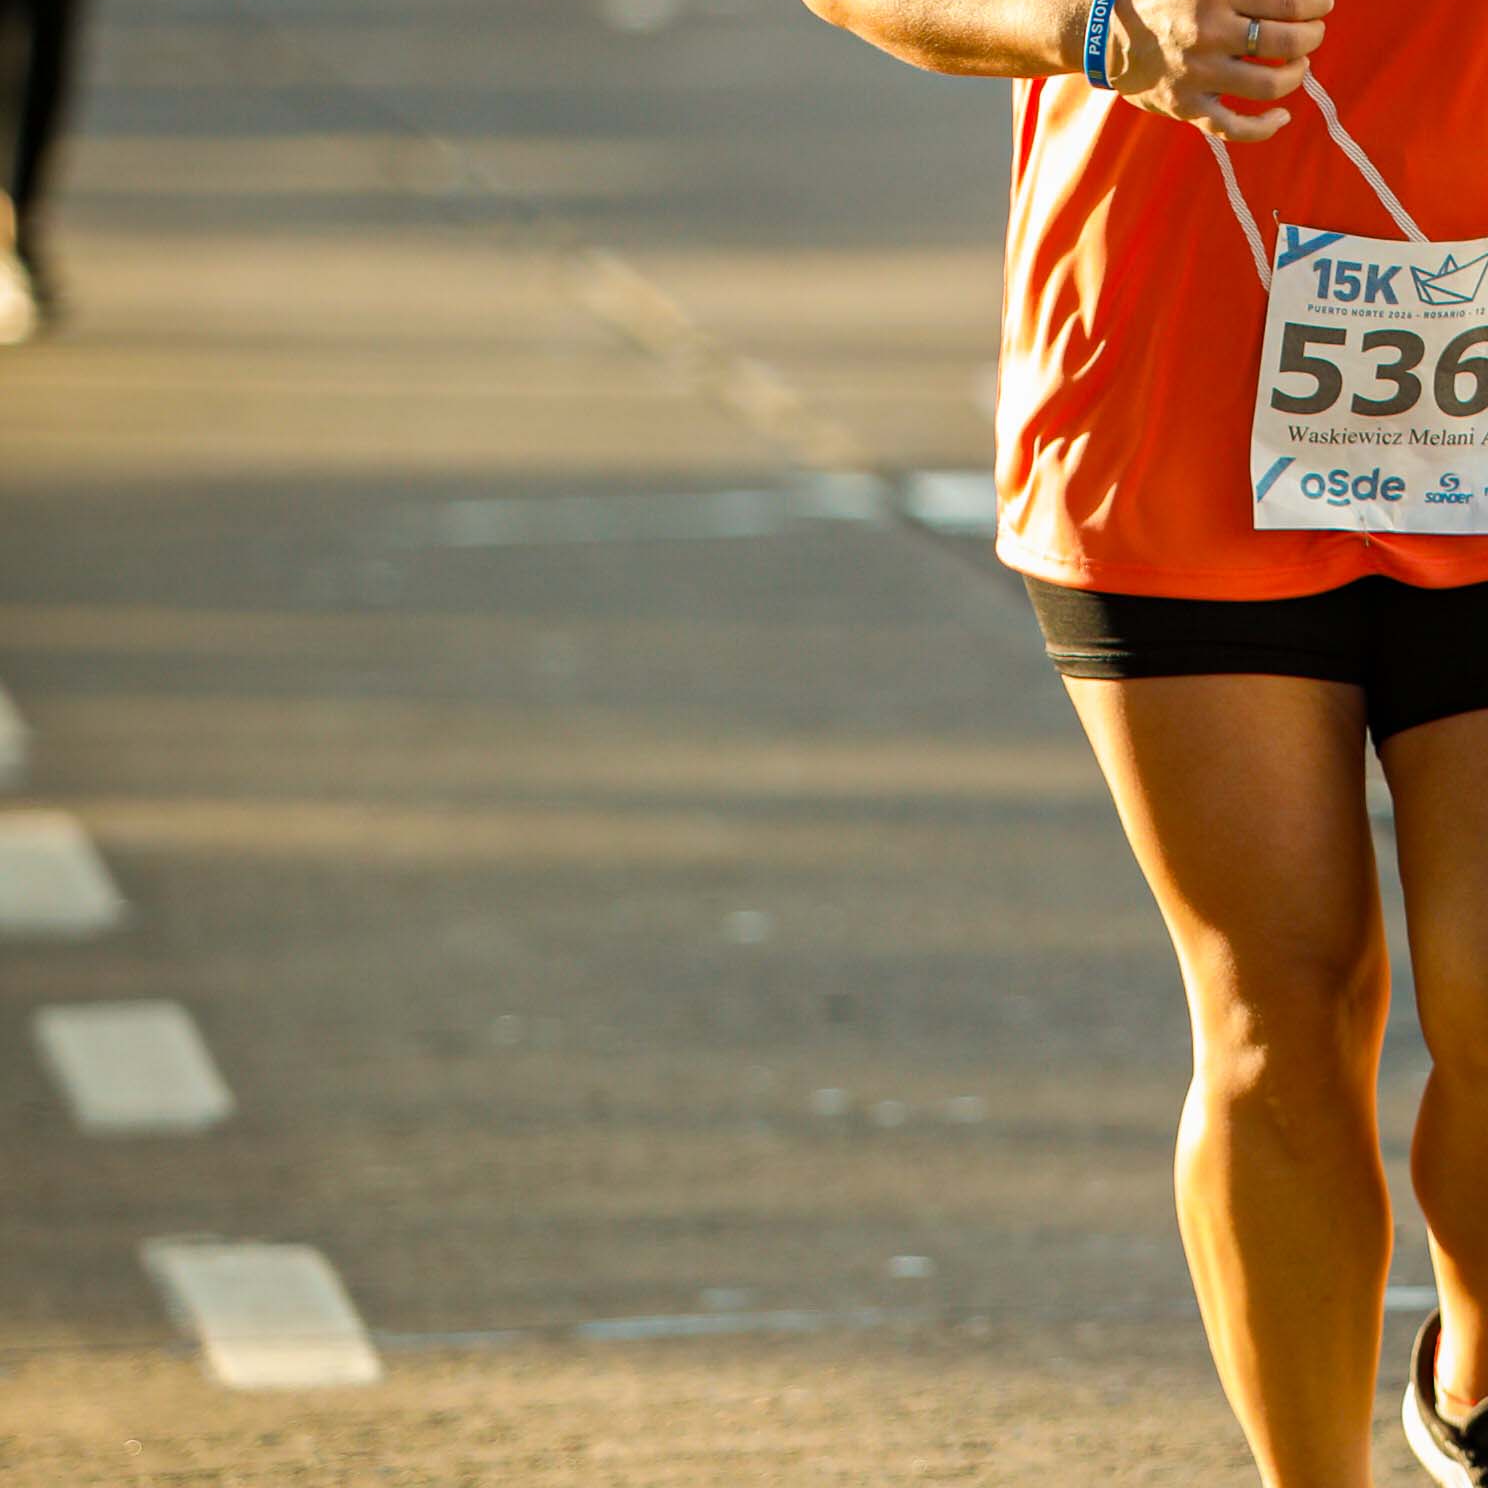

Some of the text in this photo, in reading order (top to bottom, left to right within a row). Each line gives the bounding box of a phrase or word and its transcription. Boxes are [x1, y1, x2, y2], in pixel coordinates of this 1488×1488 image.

[1312, 257, 1403, 305] 15K
[1307, 303, 1348, 316] PUERTO
[1351, 308, 1385, 318] NORTE
[1423, 310, 1466, 319] ROSARIO
[1288, 424, 1403, 446] Waskiewicz
[1408, 427, 1475, 447] Melani
[1300, 468, 1405, 503] osde
